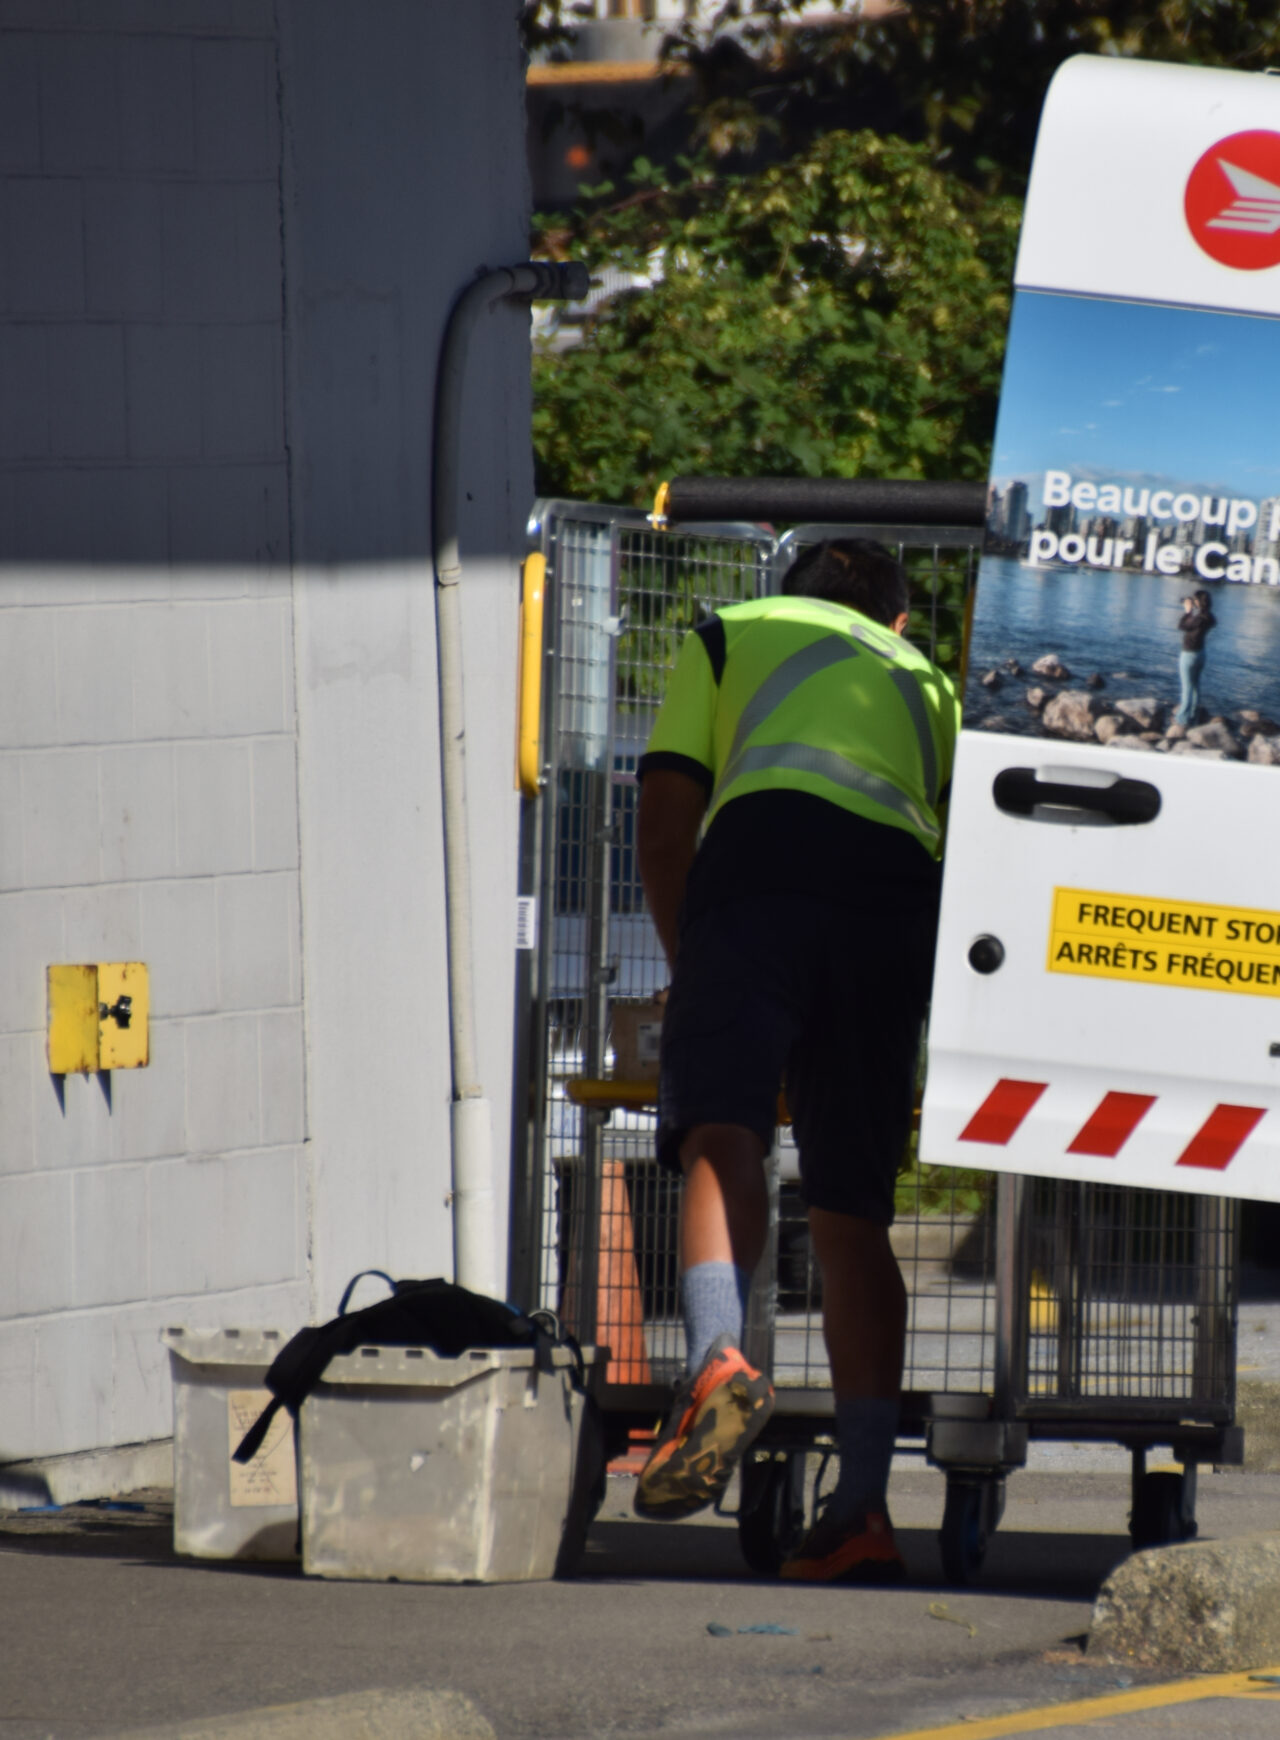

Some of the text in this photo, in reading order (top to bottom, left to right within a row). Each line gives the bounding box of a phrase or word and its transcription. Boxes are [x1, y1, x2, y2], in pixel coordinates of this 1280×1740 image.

[1043, 470, 1257, 537] Beaucoup
[1028, 529, 1135, 568] pour
[1144, 532, 1183, 575] le
[1077, 902, 1218, 938] FREQUENT
[1055, 941, 1158, 972] ARRÊTS
